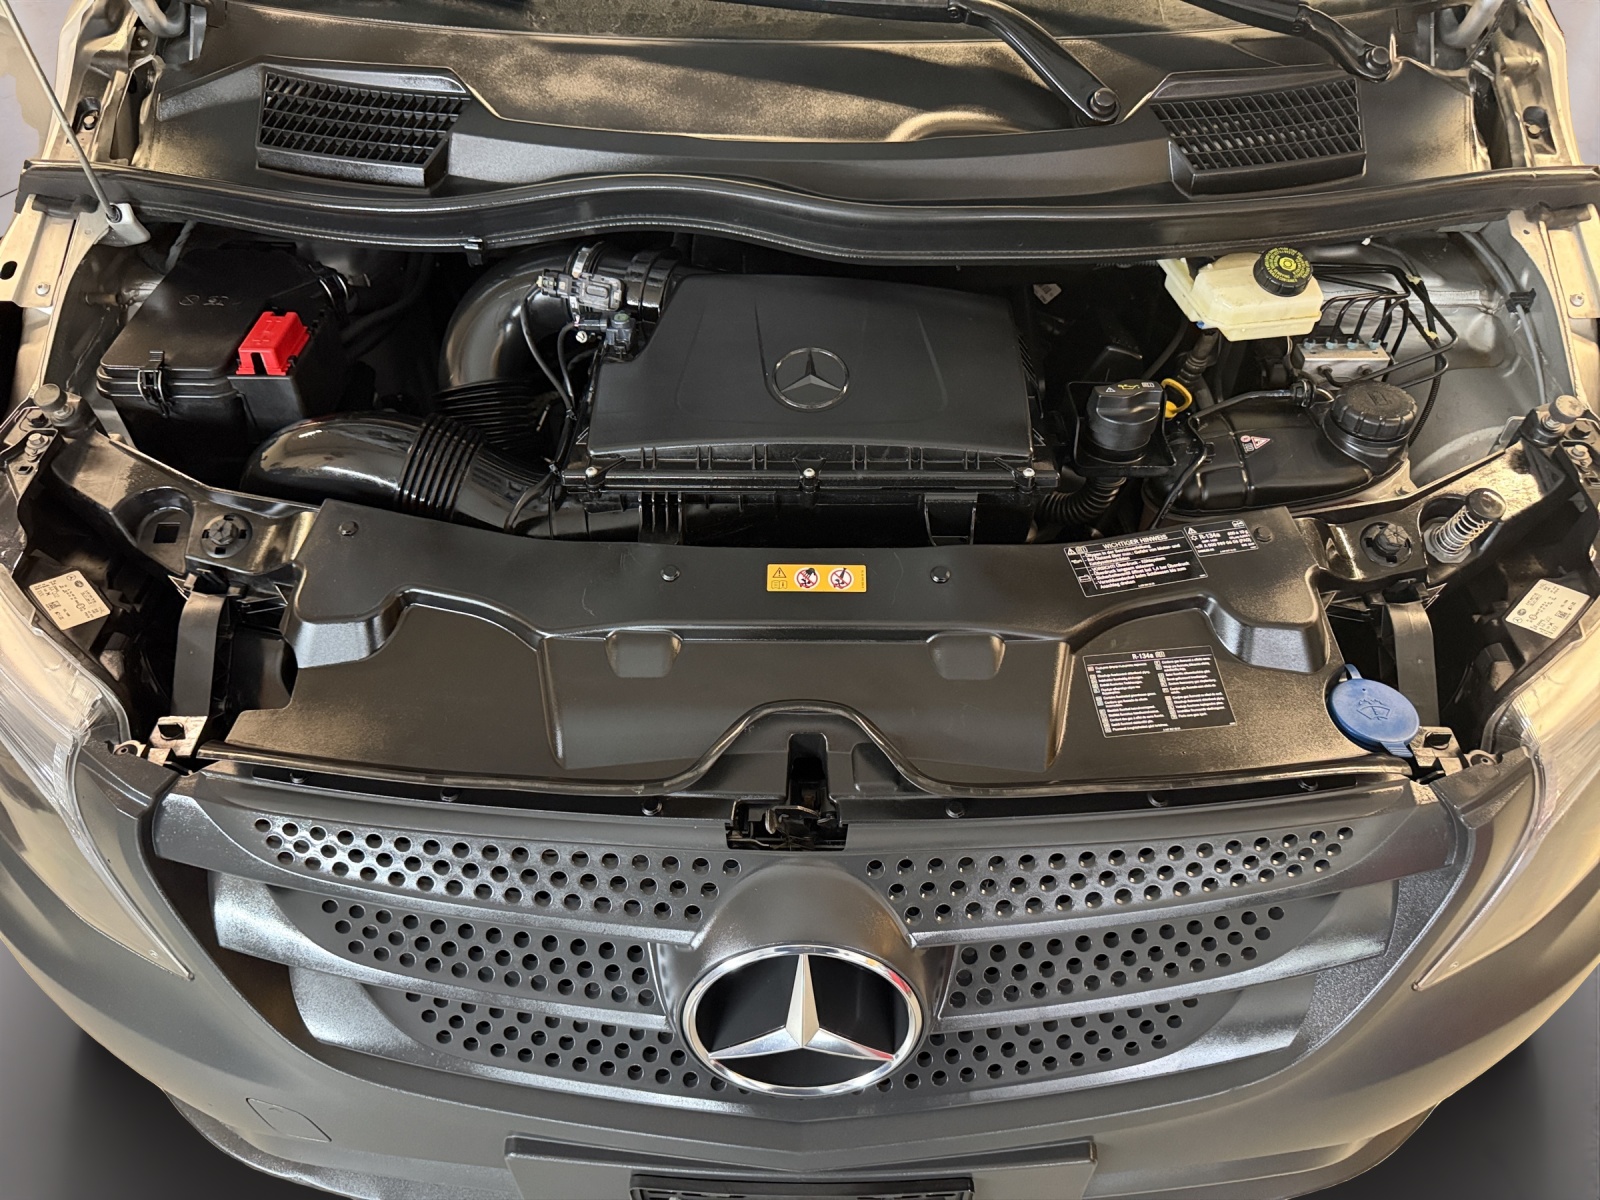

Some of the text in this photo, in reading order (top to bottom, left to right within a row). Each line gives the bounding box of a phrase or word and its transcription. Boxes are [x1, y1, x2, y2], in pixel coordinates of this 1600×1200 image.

[1102, 534, 1168, 549] WICHTIGER HINWEIS
[1131, 652, 1155, 660] R-134a
